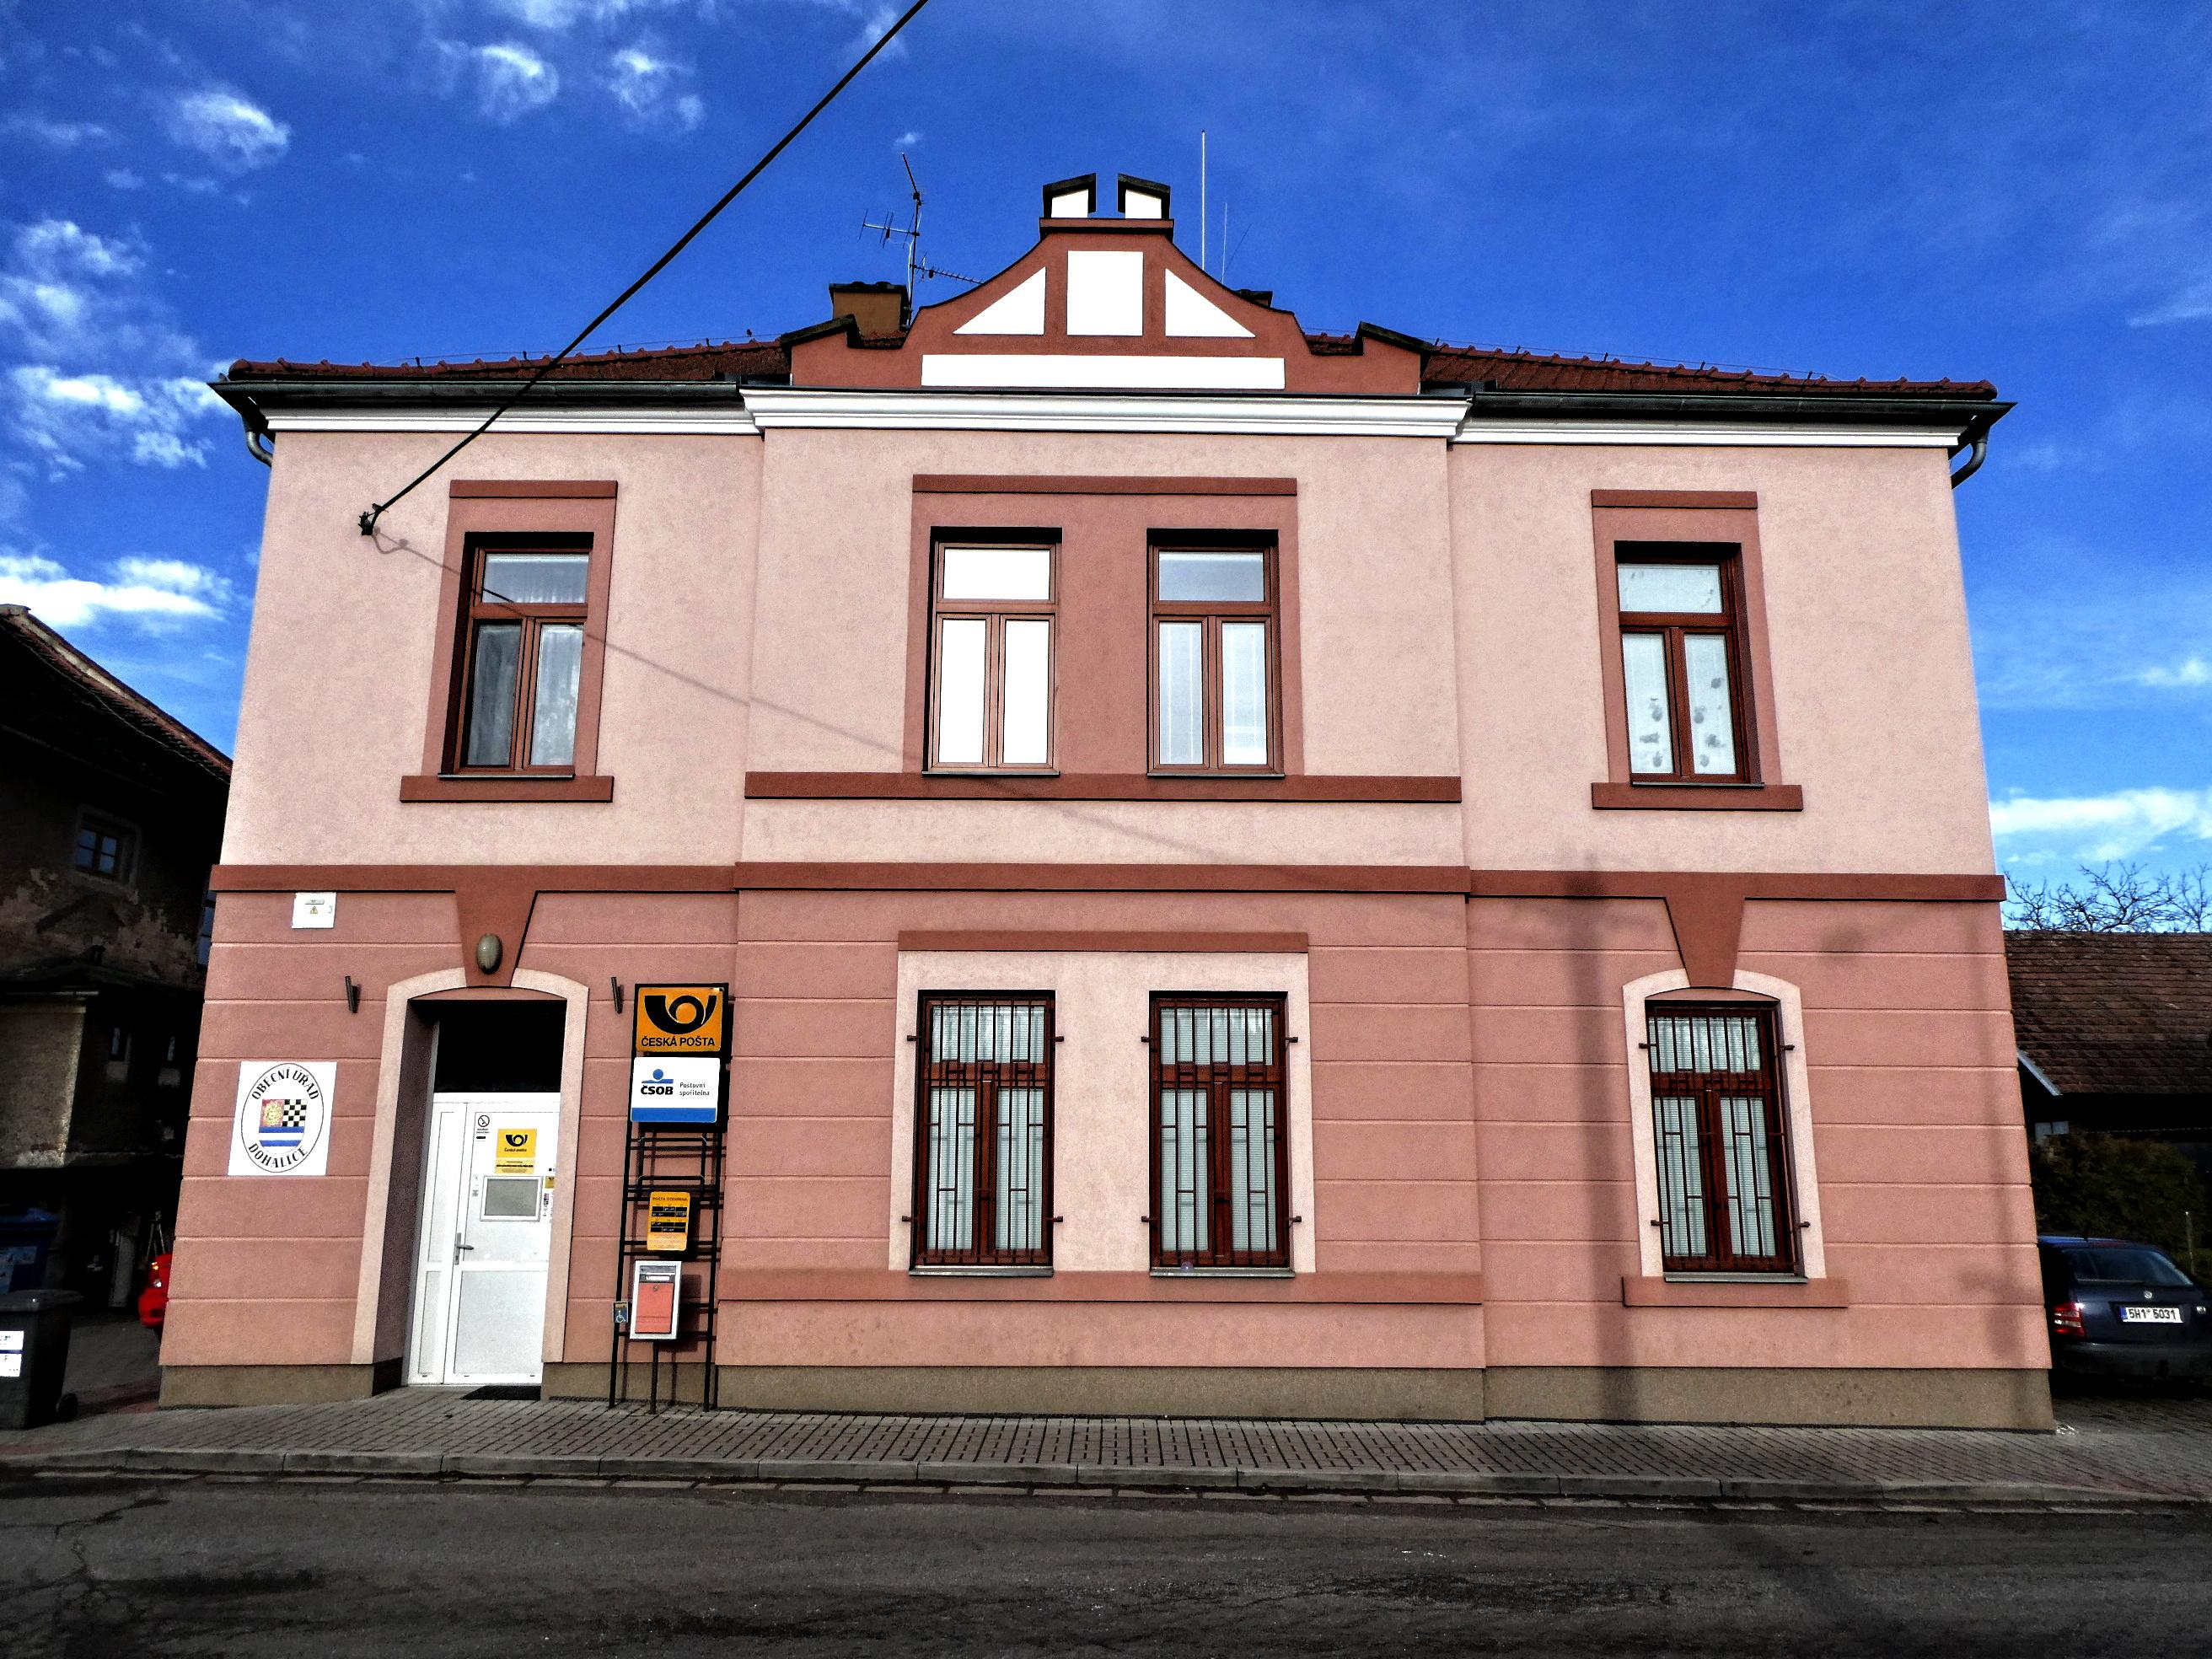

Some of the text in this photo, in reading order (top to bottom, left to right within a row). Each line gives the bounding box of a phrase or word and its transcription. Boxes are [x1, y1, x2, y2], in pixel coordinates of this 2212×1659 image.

[642, 1035, 715, 1046] ČESKÁ POŠTA
[251, 1067, 319, 1099] OBECNÍ ÚŘAD
[641, 1085, 674, 1095] ČSOB
[248, 1142, 309, 1168] DOHALICE
[2128, 1308, 2177, 1319] 5H1 5031
